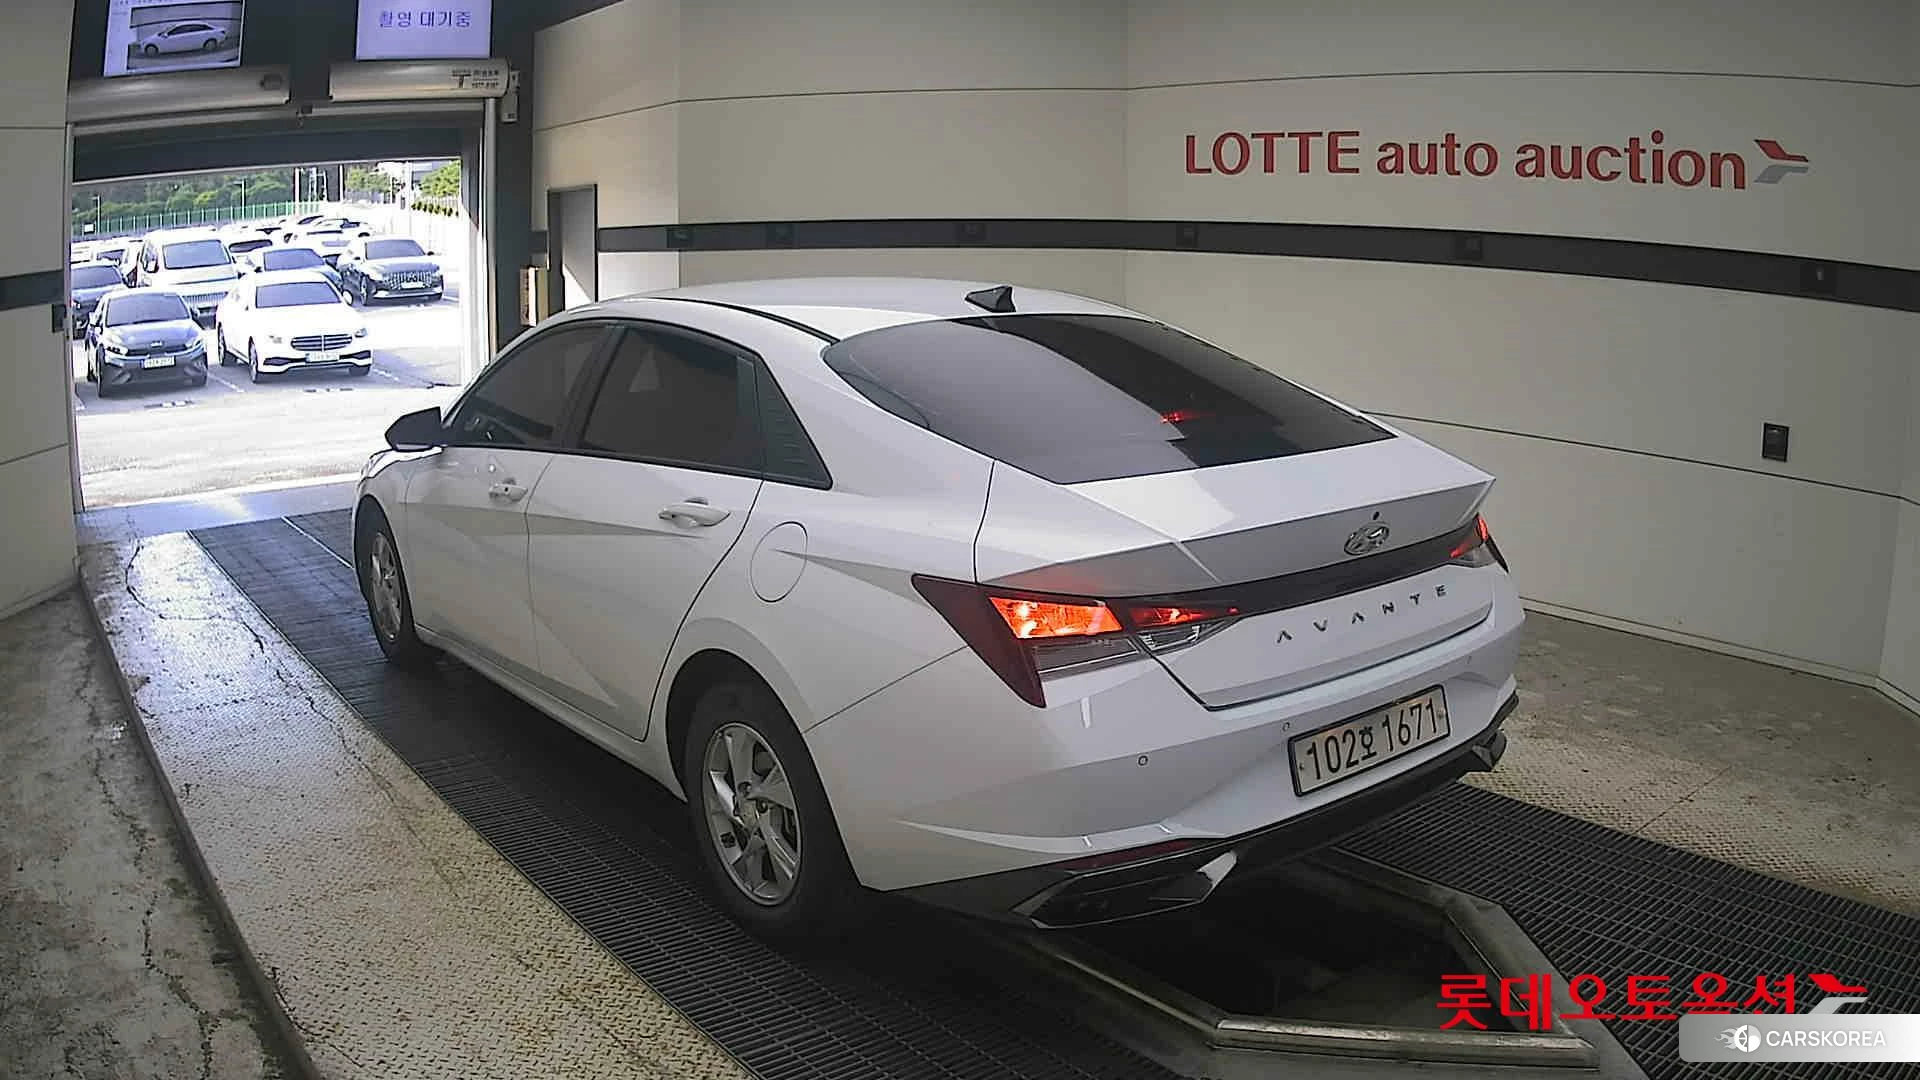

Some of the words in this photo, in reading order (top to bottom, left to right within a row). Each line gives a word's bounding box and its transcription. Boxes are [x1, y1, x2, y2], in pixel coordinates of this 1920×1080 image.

[420, 10, 472, 28] 대기중
[1185, 130, 1361, 175] LOTTE
[1377, 132, 1499, 177] auto
[1515, 130, 1747, 190] auction
[1276, 584, 1447, 644] AVANTE
[1306, 725, 1377, 780] 102호
[1382, 697, 1438, 753] 1671
